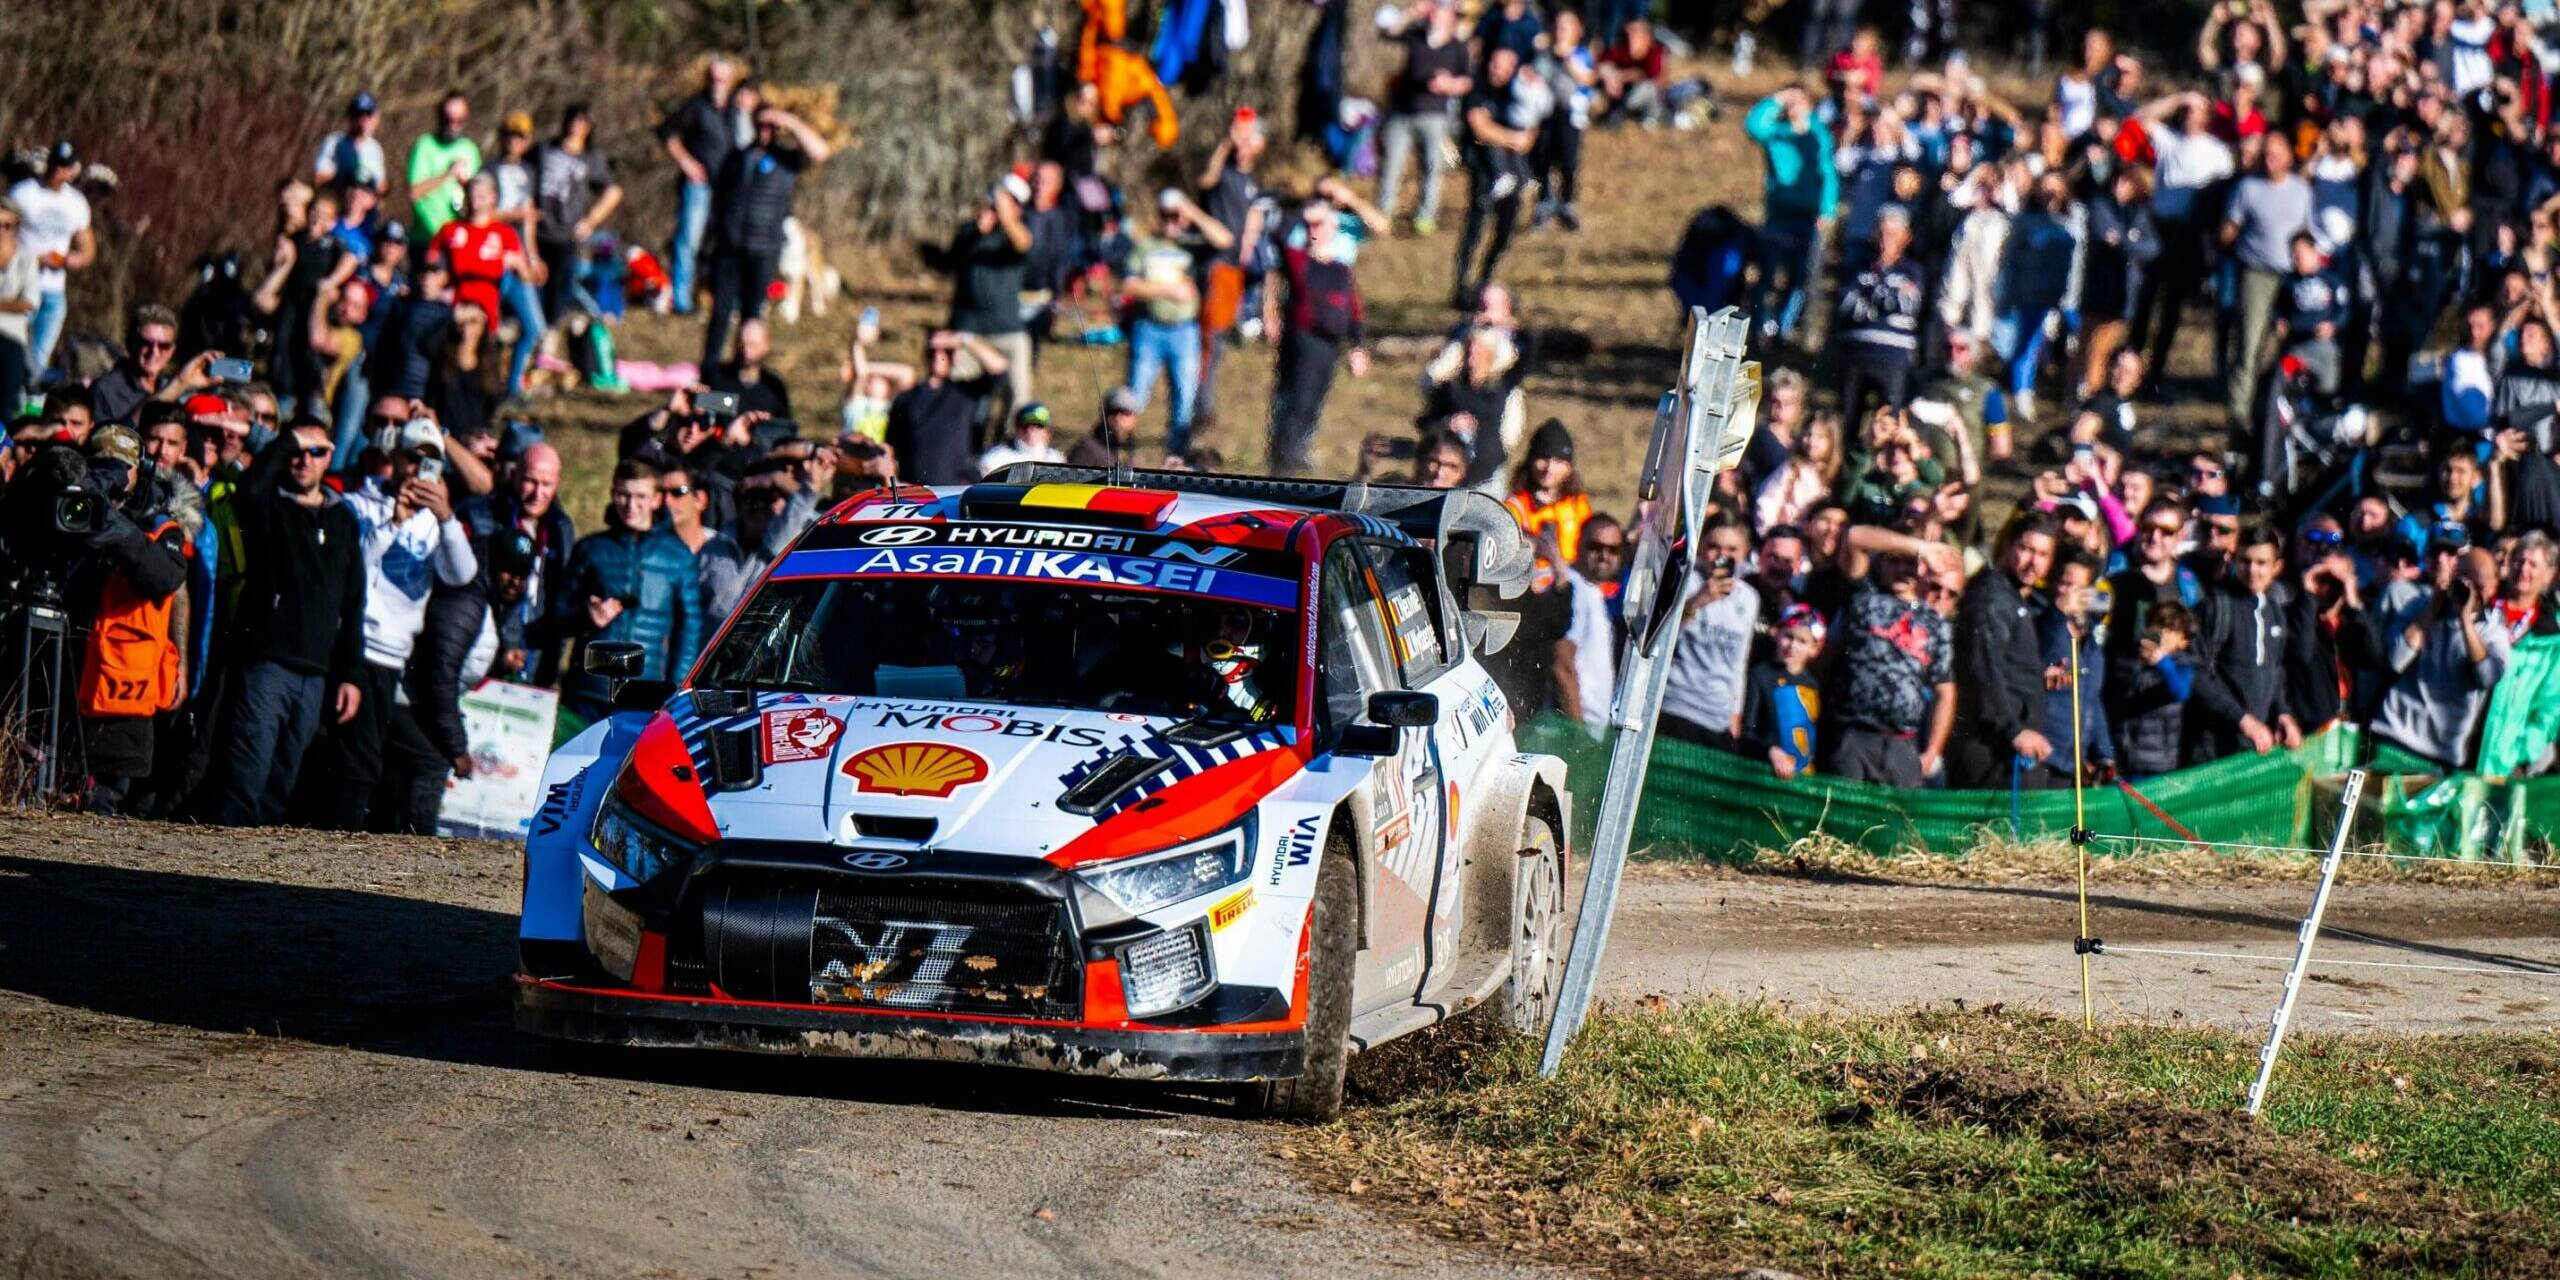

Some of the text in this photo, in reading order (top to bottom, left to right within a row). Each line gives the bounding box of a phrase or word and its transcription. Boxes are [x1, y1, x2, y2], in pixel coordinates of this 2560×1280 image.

[881, 504, 918, 519] 11
[948, 527, 1136, 551] HYUNDAI
[107, 678, 149, 700] 127
[855, 702, 1017, 718] HYUNDAI
[873, 711, 1106, 747] MOBIS
[1287, 815, 1321, 867] WIA
[1269, 836, 1290, 886] HYUNDAI
